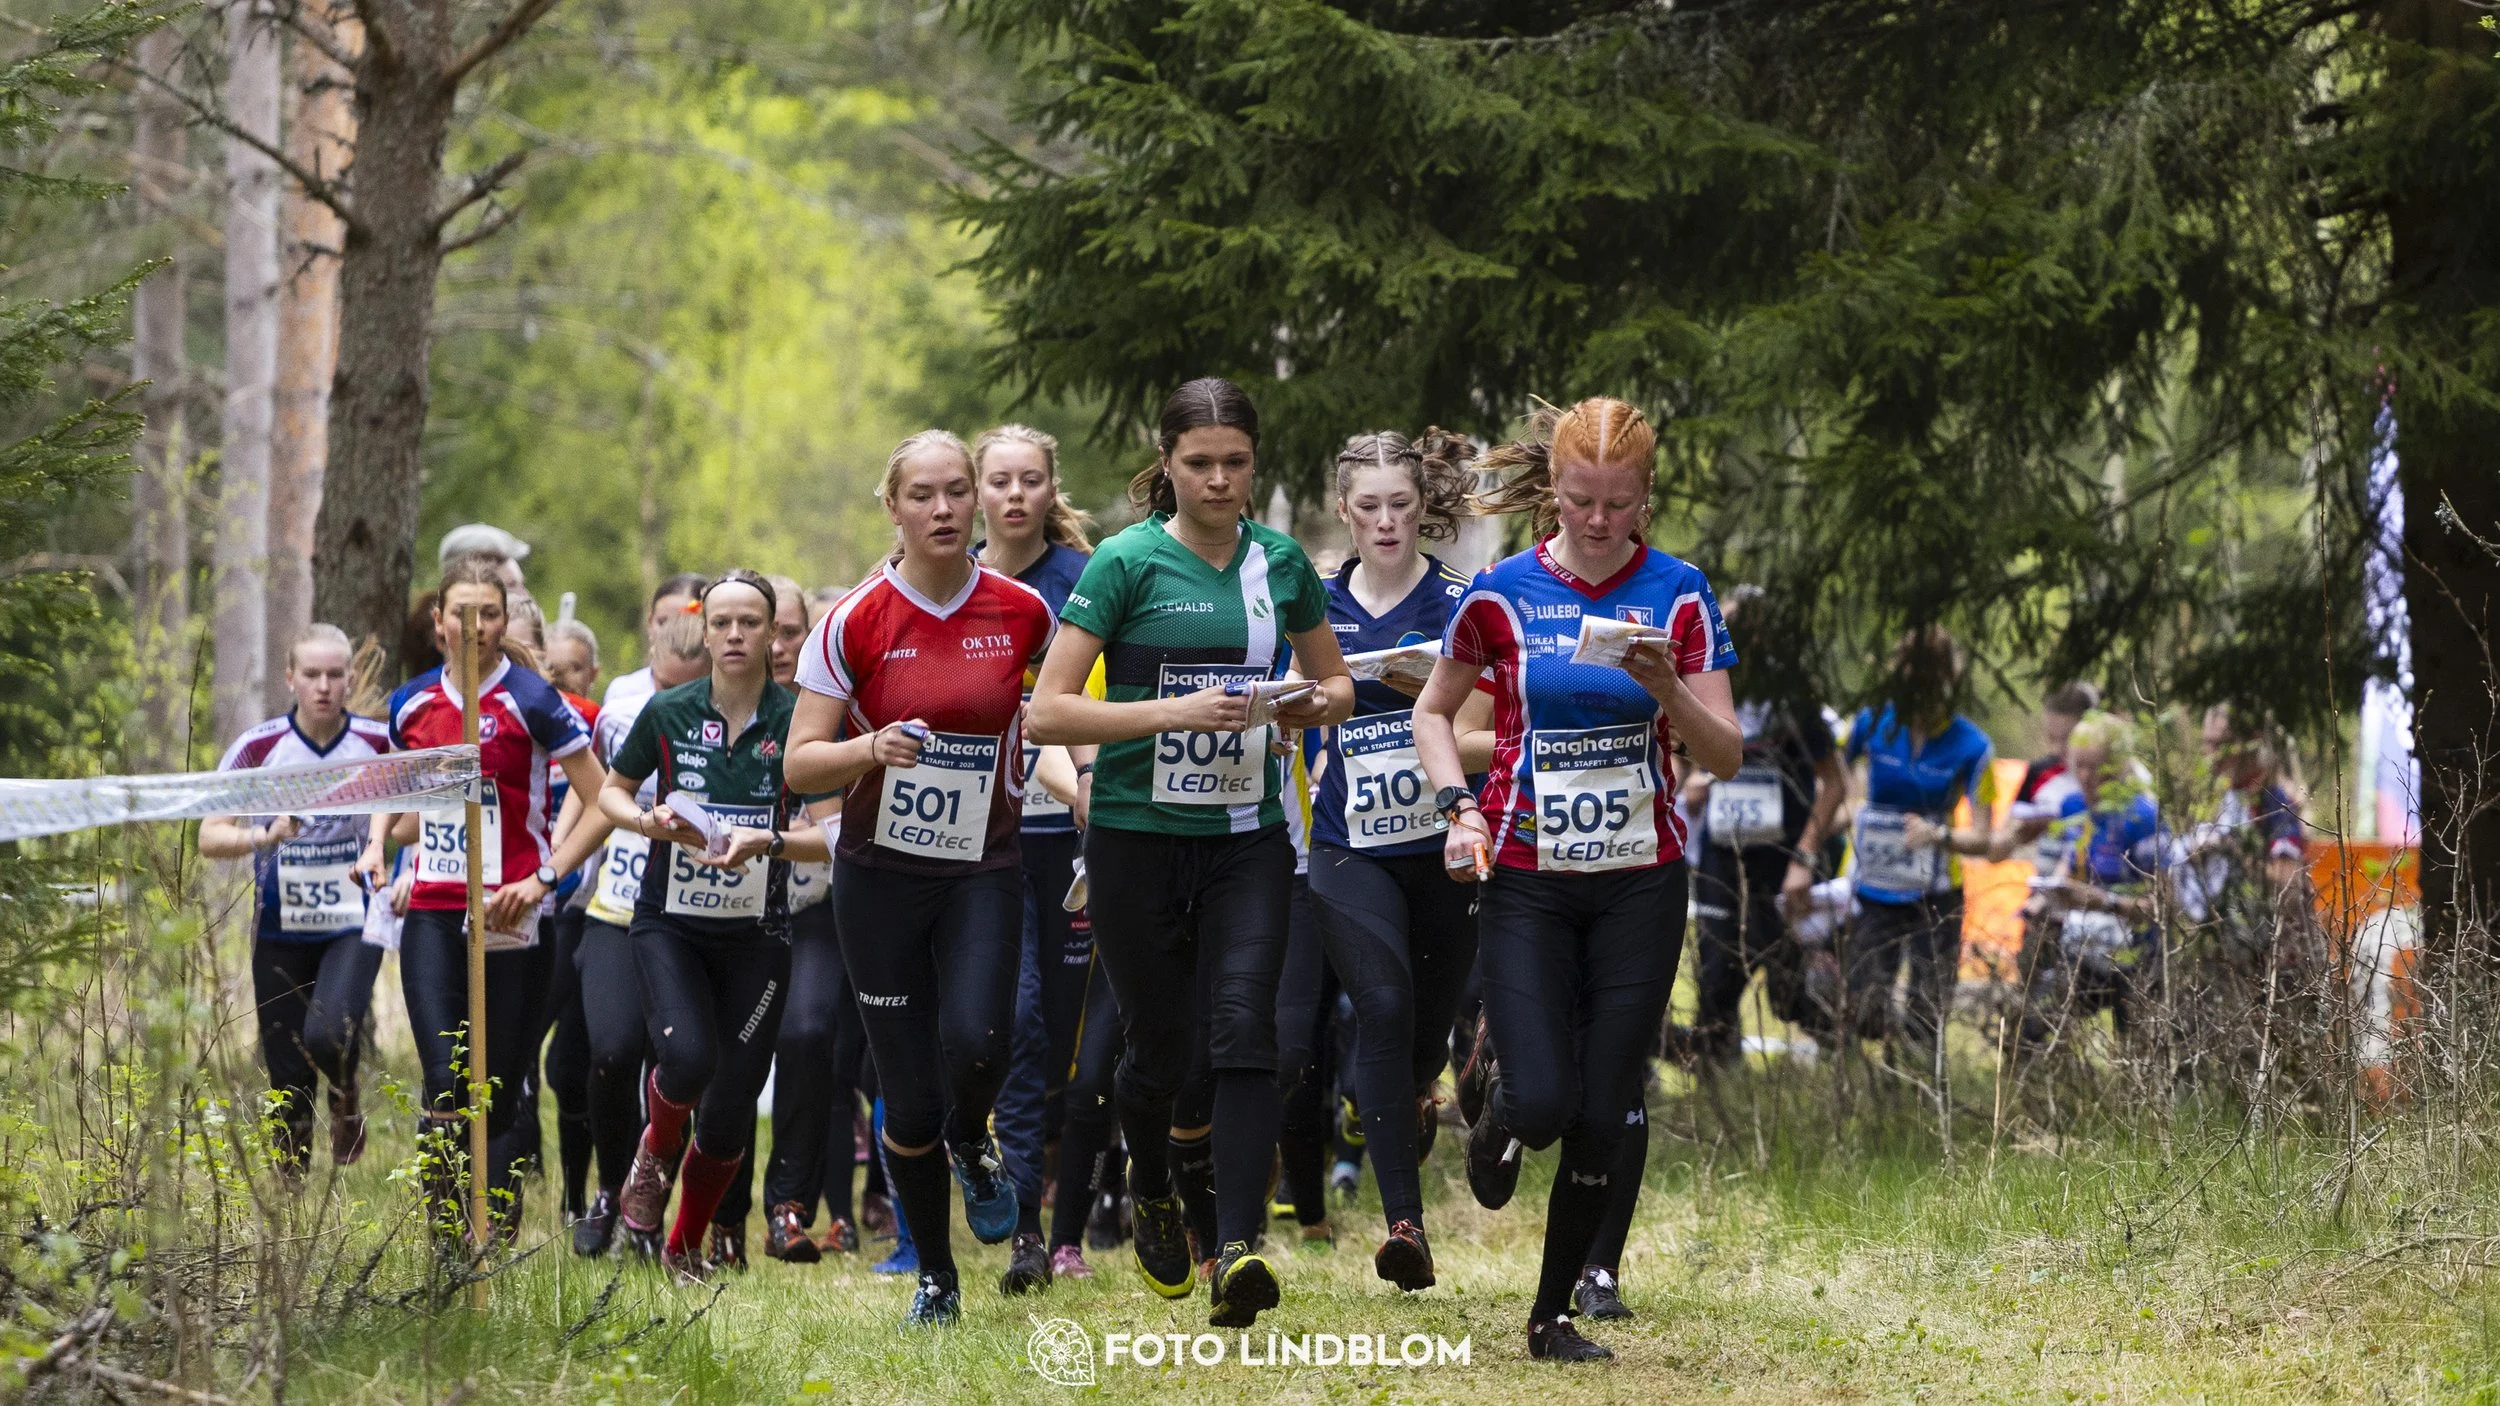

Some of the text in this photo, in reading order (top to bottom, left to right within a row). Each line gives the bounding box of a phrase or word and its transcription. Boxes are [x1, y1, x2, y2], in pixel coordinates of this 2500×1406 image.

[1538, 551, 1577, 584] TRIMTEX
[1536, 604, 1581, 619] LULEBO
[962, 634, 1012, 650] OK TYR
[965, 649, 1014, 660] KARLSTAD
[1341, 719, 1413, 743] baghee
[922, 738, 995, 757] gheera
[1157, 730, 1245, 767] 504
[1371, 740, 1400, 751] STAFETT
[1536, 733, 1645, 756] bagheera
[676, 751, 708, 769] elajo
[925, 757, 955, 767] STAFETT
[1559, 761, 1571, 769] SM
[1574, 759, 1609, 769] STAFETT
[978, 775, 987, 794] 1
[1166, 772, 1253, 793] LEDtec
[1636, 767, 1647, 789] 1
[1023, 789, 1055, 806] tec
[1352, 769, 1422, 813] 510
[889, 779, 962, 825] 501
[1542, 789, 1631, 836] 505
[487, 809, 494, 825] 1
[1361, 810, 1446, 837] LEDtec
[888, 821, 972, 850] LEDtec
[1552, 839, 1645, 862] LEDtec
[610, 846, 649, 881] 50
[286, 881, 341, 909] 535
[678, 889, 755, 909] LEDtec
[858, 991, 909, 1007] TRIMTEX
[737, 979, 778, 1044] noname
